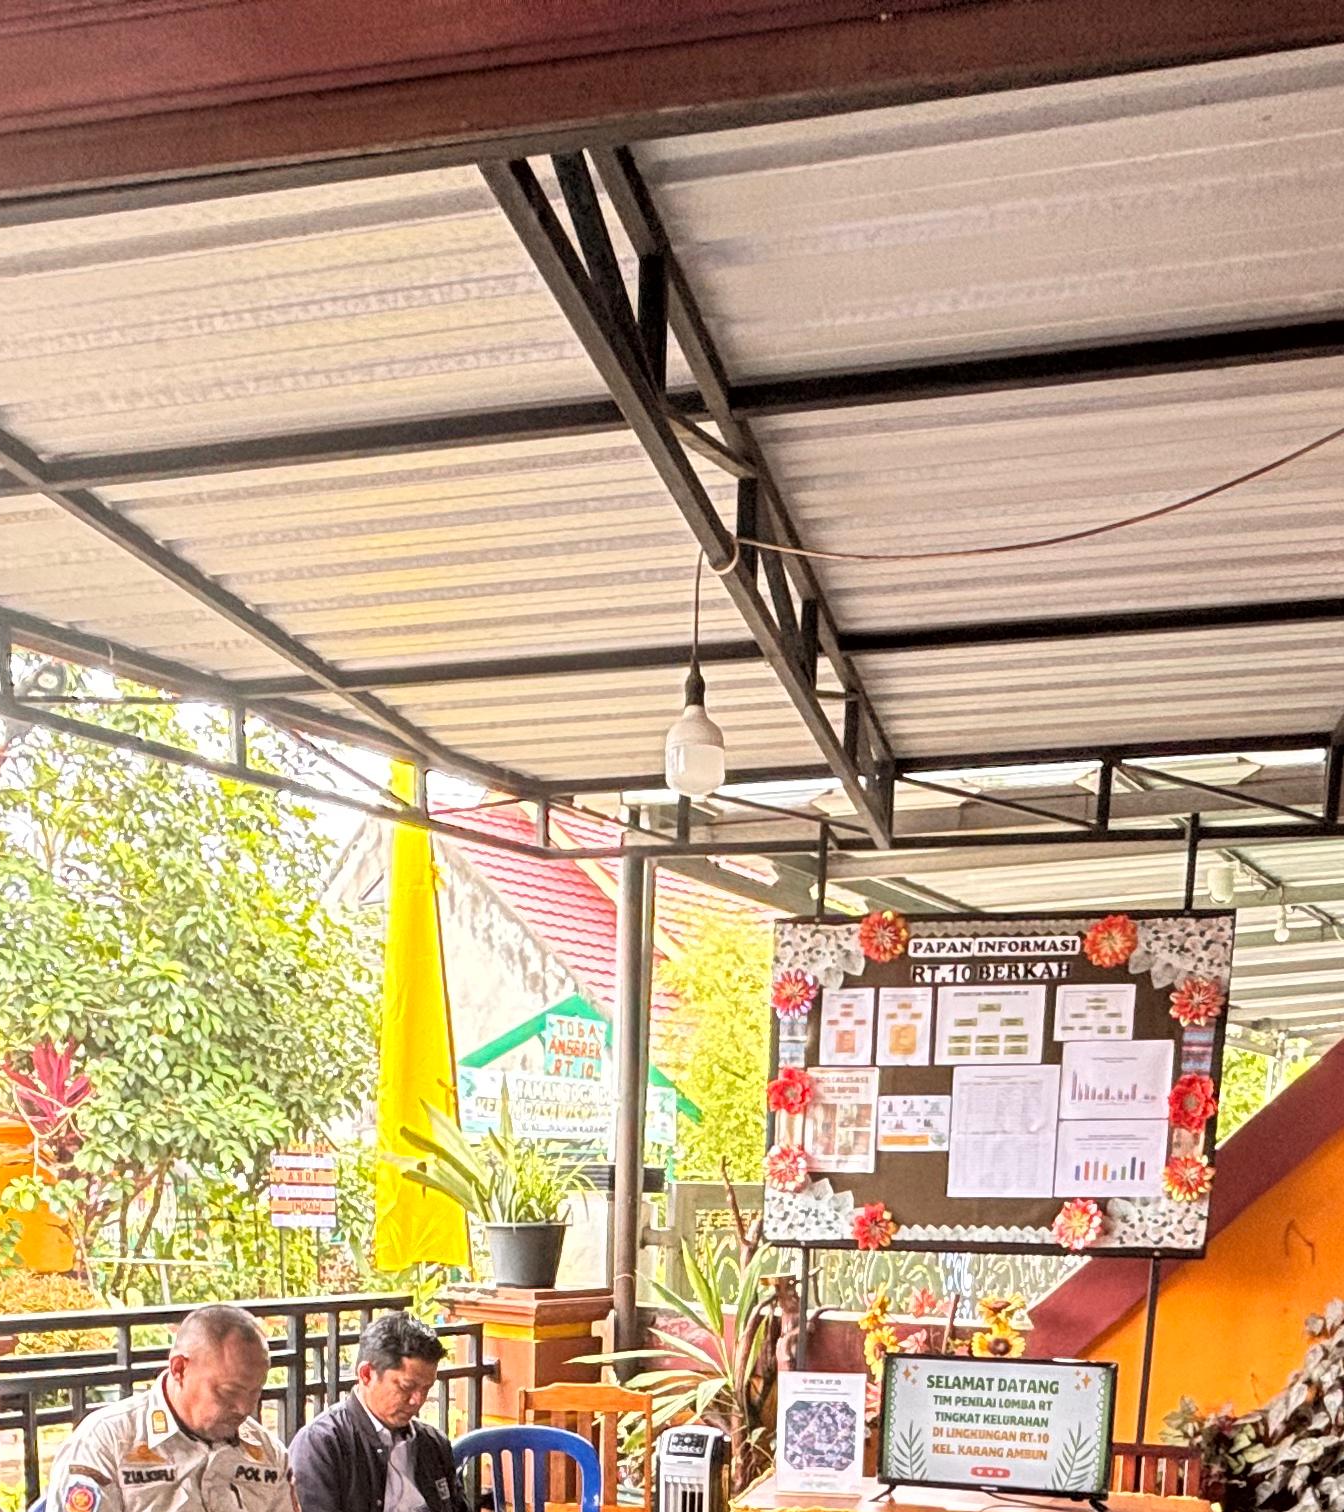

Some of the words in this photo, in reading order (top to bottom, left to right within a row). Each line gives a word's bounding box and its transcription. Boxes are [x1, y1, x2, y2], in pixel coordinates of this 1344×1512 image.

[912, 941, 973, 954] PAPAN
[977, 939, 1078, 953] INFORMASI
[912, 965, 972, 983] RT.10
[977, 962, 1072, 981] BERKAH
[926, 1374, 995, 1391] SELAMAT
[998, 1378, 1060, 1395] DATANG
[933, 1394, 952, 1406] TIM
[954, 1396, 997, 1408] PENILAI
[999, 1398, 1036, 1410] LOMBA
[1038, 1400, 1054, 1411] RT
[935, 1411, 981, 1424] TINGKAT
[983, 1414, 1049, 1428] KELURAHAN
[932, 1427, 944, 1437] DI
[946, 1428, 1017, 1442] LINGKUNGAN
[1019, 1431, 1050, 1444] RT.10
[932, 1443, 955, 1455] KEL.
[958, 1445, 1004, 1458] KARANG
[1006, 1448, 1048, 1461] AMBUN
[234, 1465, 261, 1482] POL
[263, 1469, 279, 1484] PP
